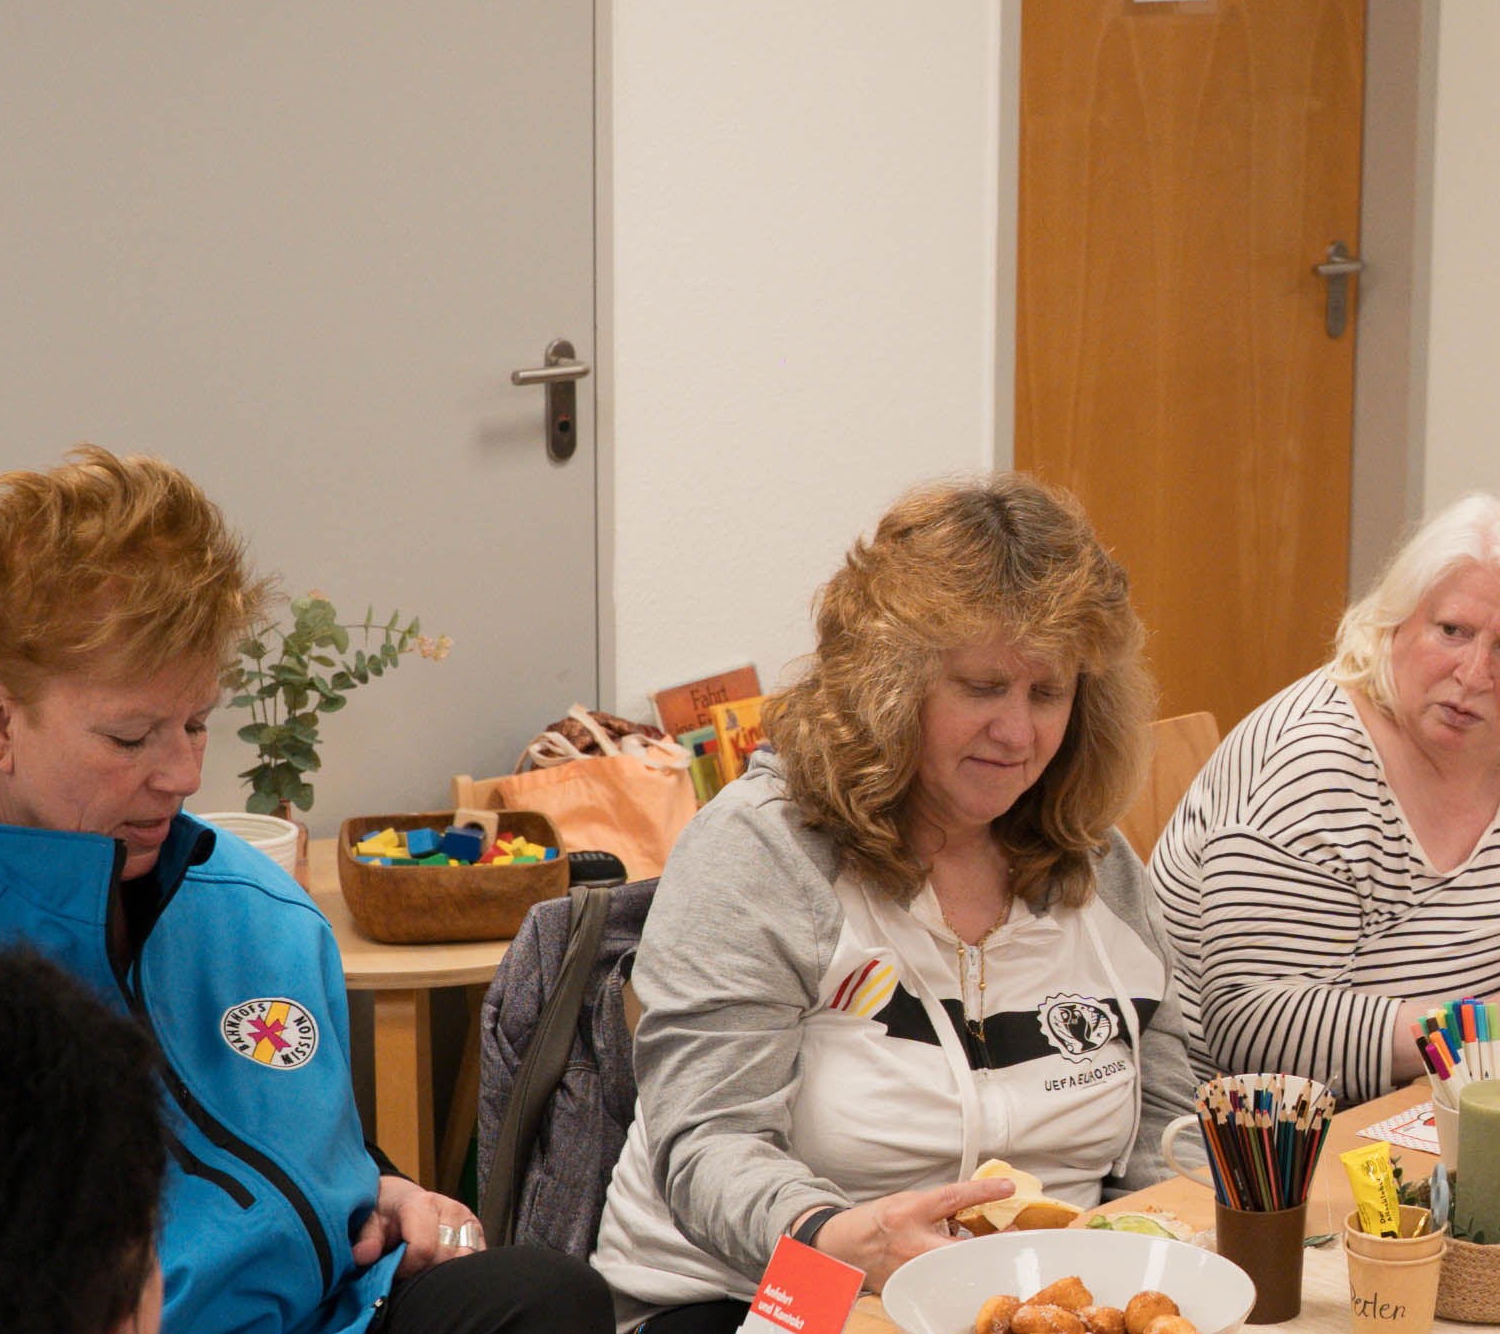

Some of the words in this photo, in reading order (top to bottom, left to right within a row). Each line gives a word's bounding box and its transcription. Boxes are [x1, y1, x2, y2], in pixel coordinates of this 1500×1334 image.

[227, 1003, 266, 1052] BAHNHOFS
[281, 1015, 312, 1065] MISSION
[1045, 1075, 1076, 1091] UEFA
